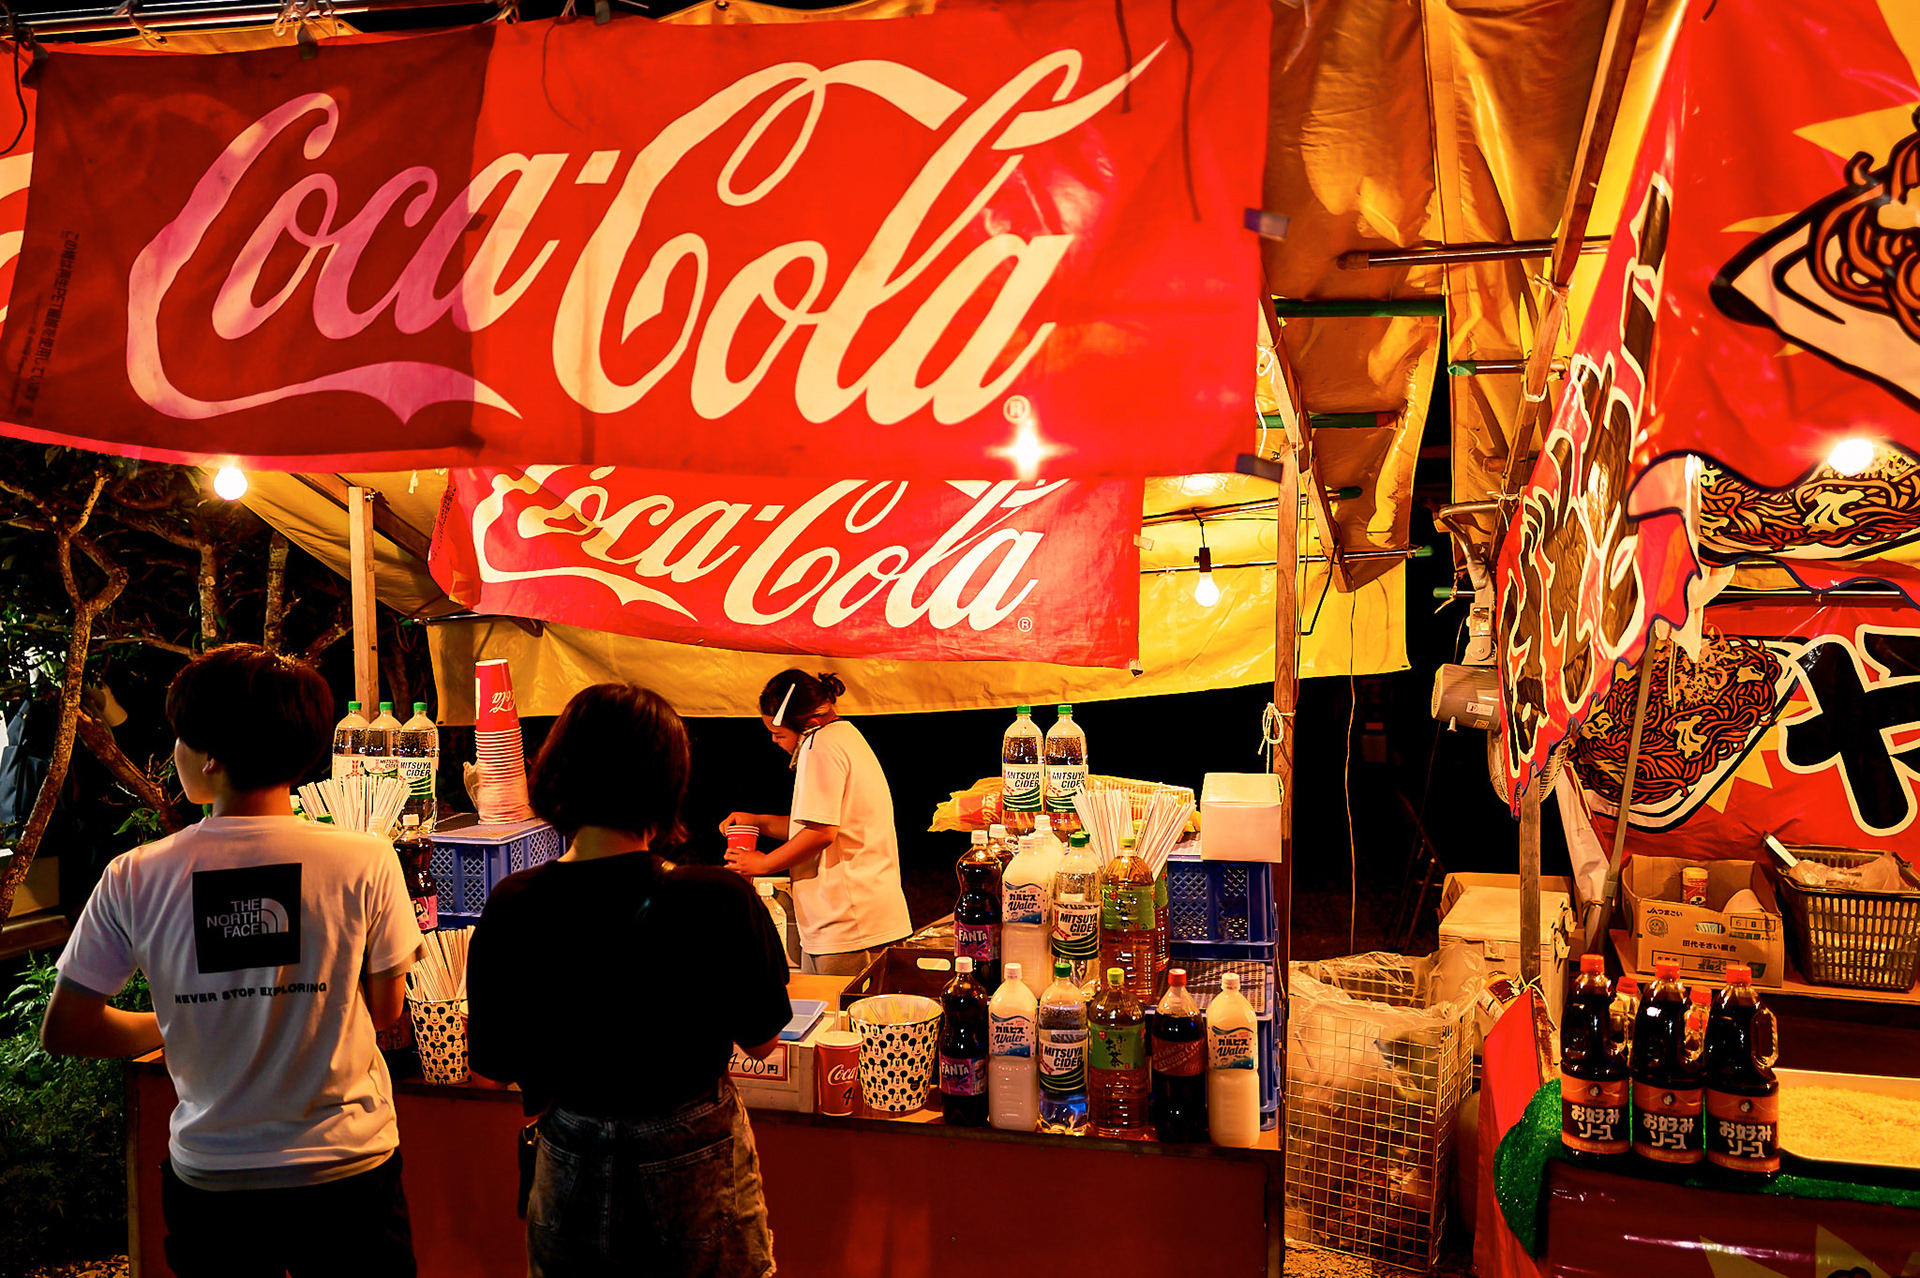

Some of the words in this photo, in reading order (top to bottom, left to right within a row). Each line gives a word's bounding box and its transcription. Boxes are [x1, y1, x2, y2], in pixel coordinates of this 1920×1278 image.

[127, 40, 1168, 426] Coca-Cola
[472, 465, 1071, 631] Coca-Cola
[400, 761, 431, 770] MITSUYA
[406, 769, 431, 777] CIDER
[1006, 771, 1040, 780] MITSUYA
[1014, 779, 1040, 788] CIDER
[230, 898, 260, 913] THE
[1008, 900, 1038, 911] Water
[206, 910, 260, 928] NORTH
[1060, 912, 1098, 923] MITSUYA
[223, 923, 260, 938] FACE
[1070, 922, 1098, 933] CIDER
[958, 928, 988, 943] FANTA
[174, 992, 218, 1004] NEVER
[222, 987, 256, 1000] STOP
[260, 982, 327, 997] EXPLORING
[994, 1033, 1025, 1044] Water
[1043, 1045, 1083, 1058] MITSUYA
[1216, 1045, 1249, 1057] Water
[941, 1061, 970, 1076] FANTA
[1053, 1056, 1083, 1068] CIDER
[1570, 1104, 1620, 1124] お好み
[1643, 1112, 1695, 1133] お好み
[1577, 1121, 1614, 1141] ソース
[1719, 1120, 1773, 1142] お好み
[1650, 1130, 1688, 1150] ソース
[1726, 1139, 1766, 1158] ソース
